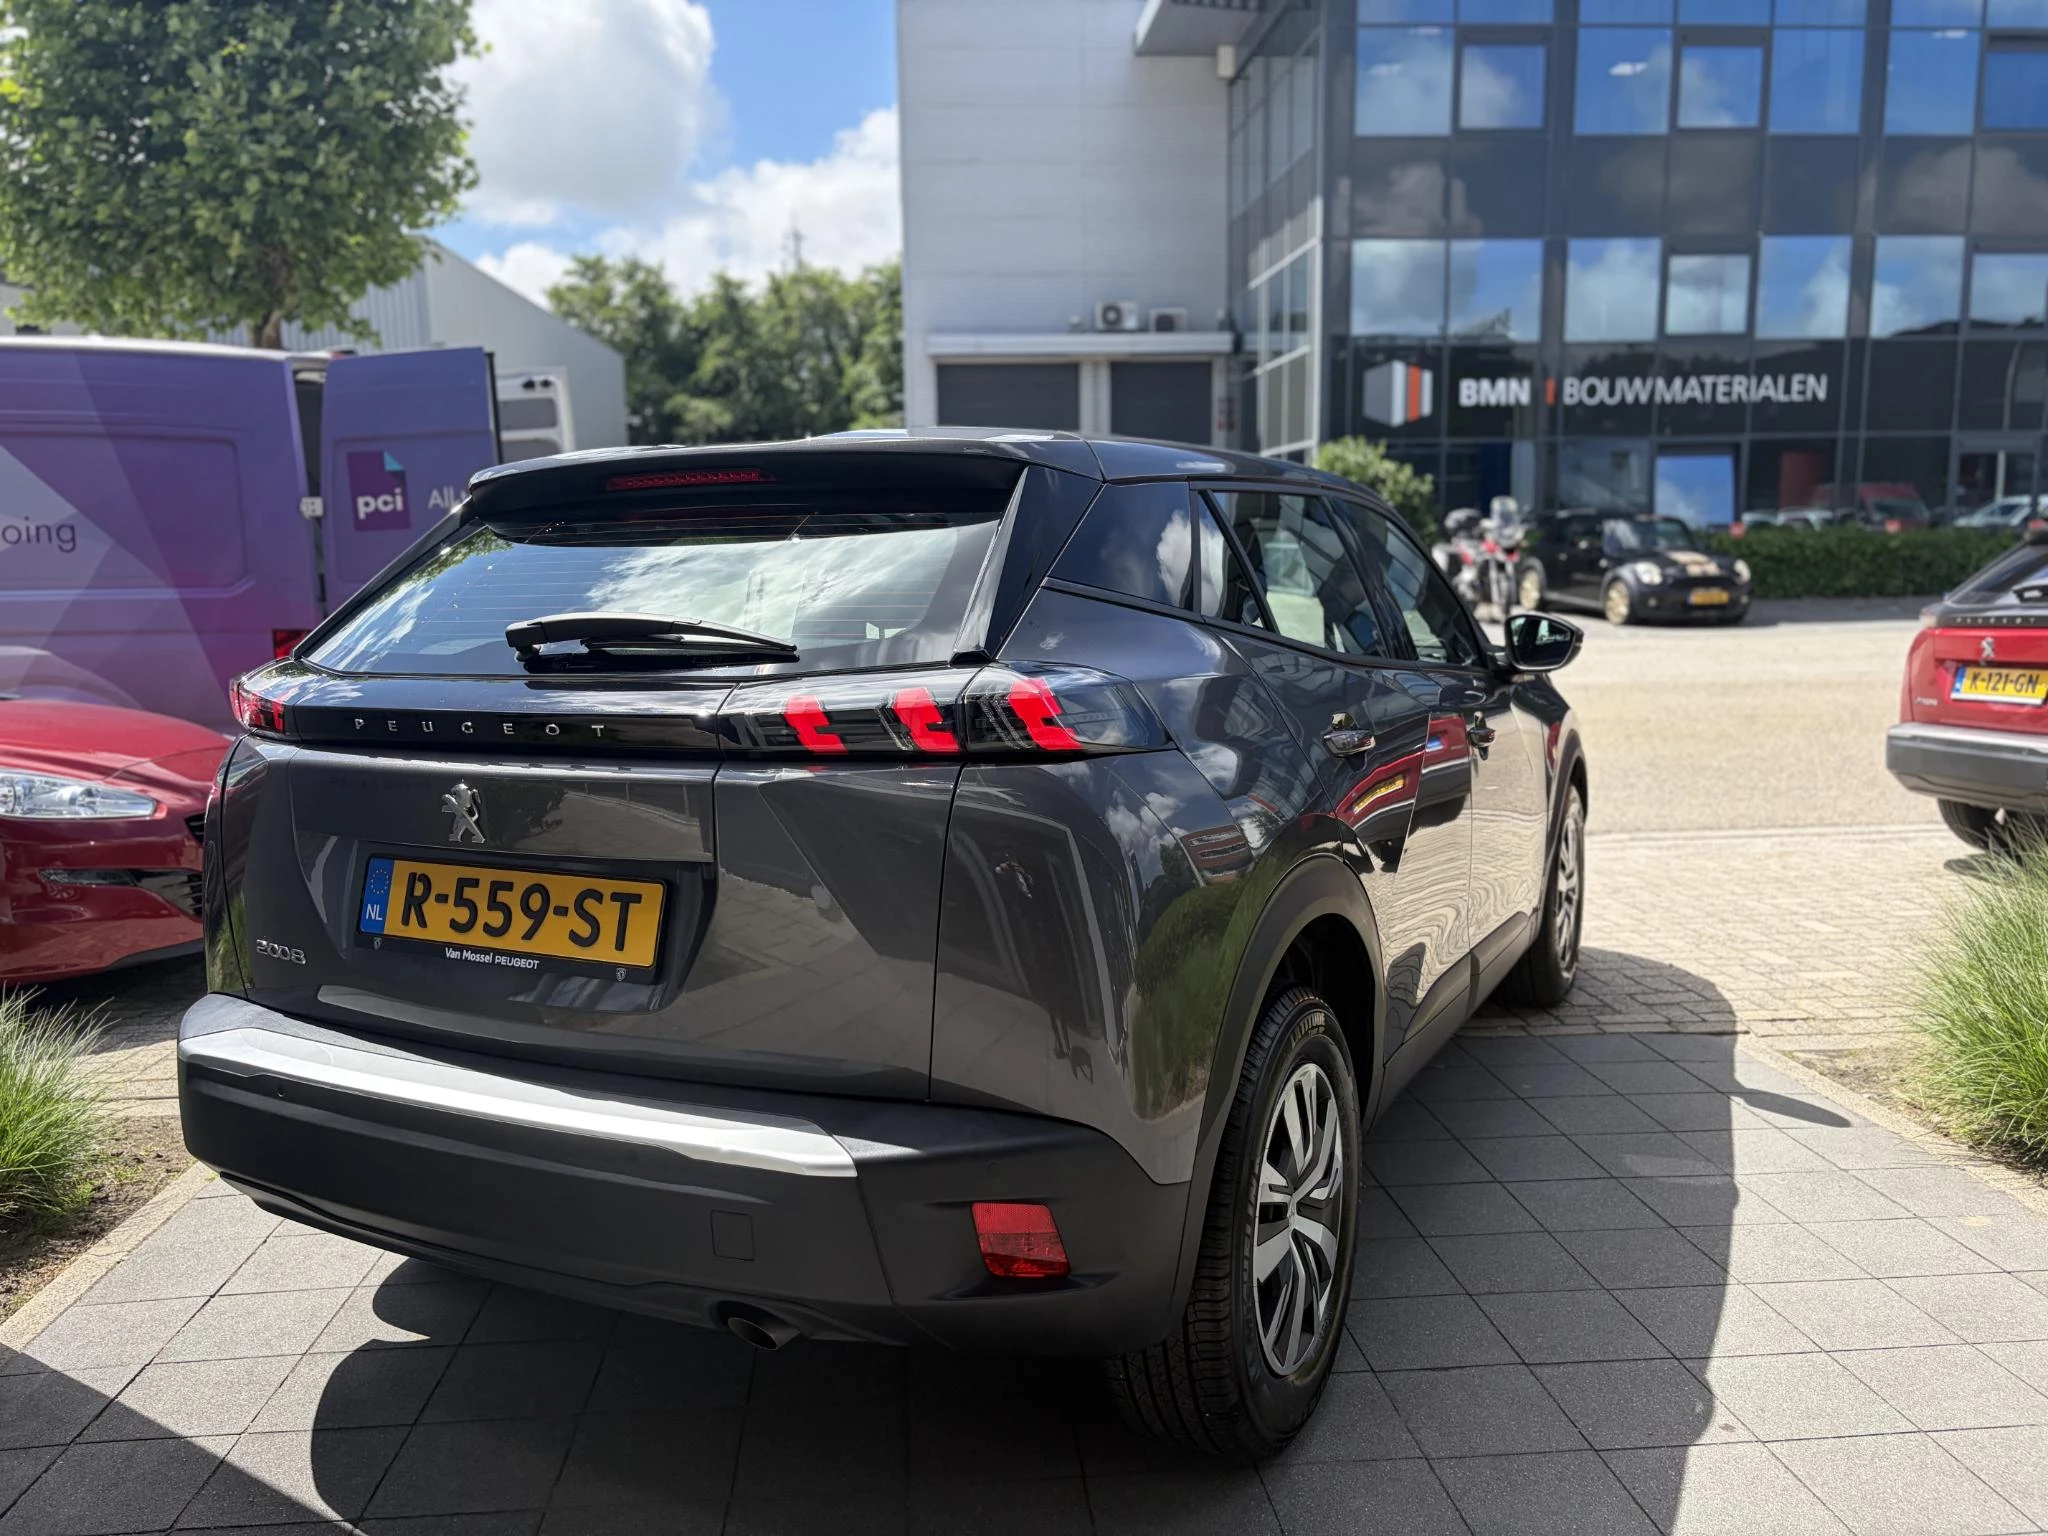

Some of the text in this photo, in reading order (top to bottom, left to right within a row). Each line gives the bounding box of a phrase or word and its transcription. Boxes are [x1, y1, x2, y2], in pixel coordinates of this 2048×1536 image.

[1458, 373, 1828, 407] BMN BOUWMATERIALEN
[356, 487, 404, 520] pci
[1, 515, 76, 554] oing
[1970, 671, 2040, 694] K-121-GN
[354, 718, 605, 737] PEUGEOT
[365, 903, 383, 921] NL
[401, 871, 643, 952] R-559-ST
[256, 939, 306, 965] 2008
[445, 946, 540, 970] Van Mossel PEUGEOT
